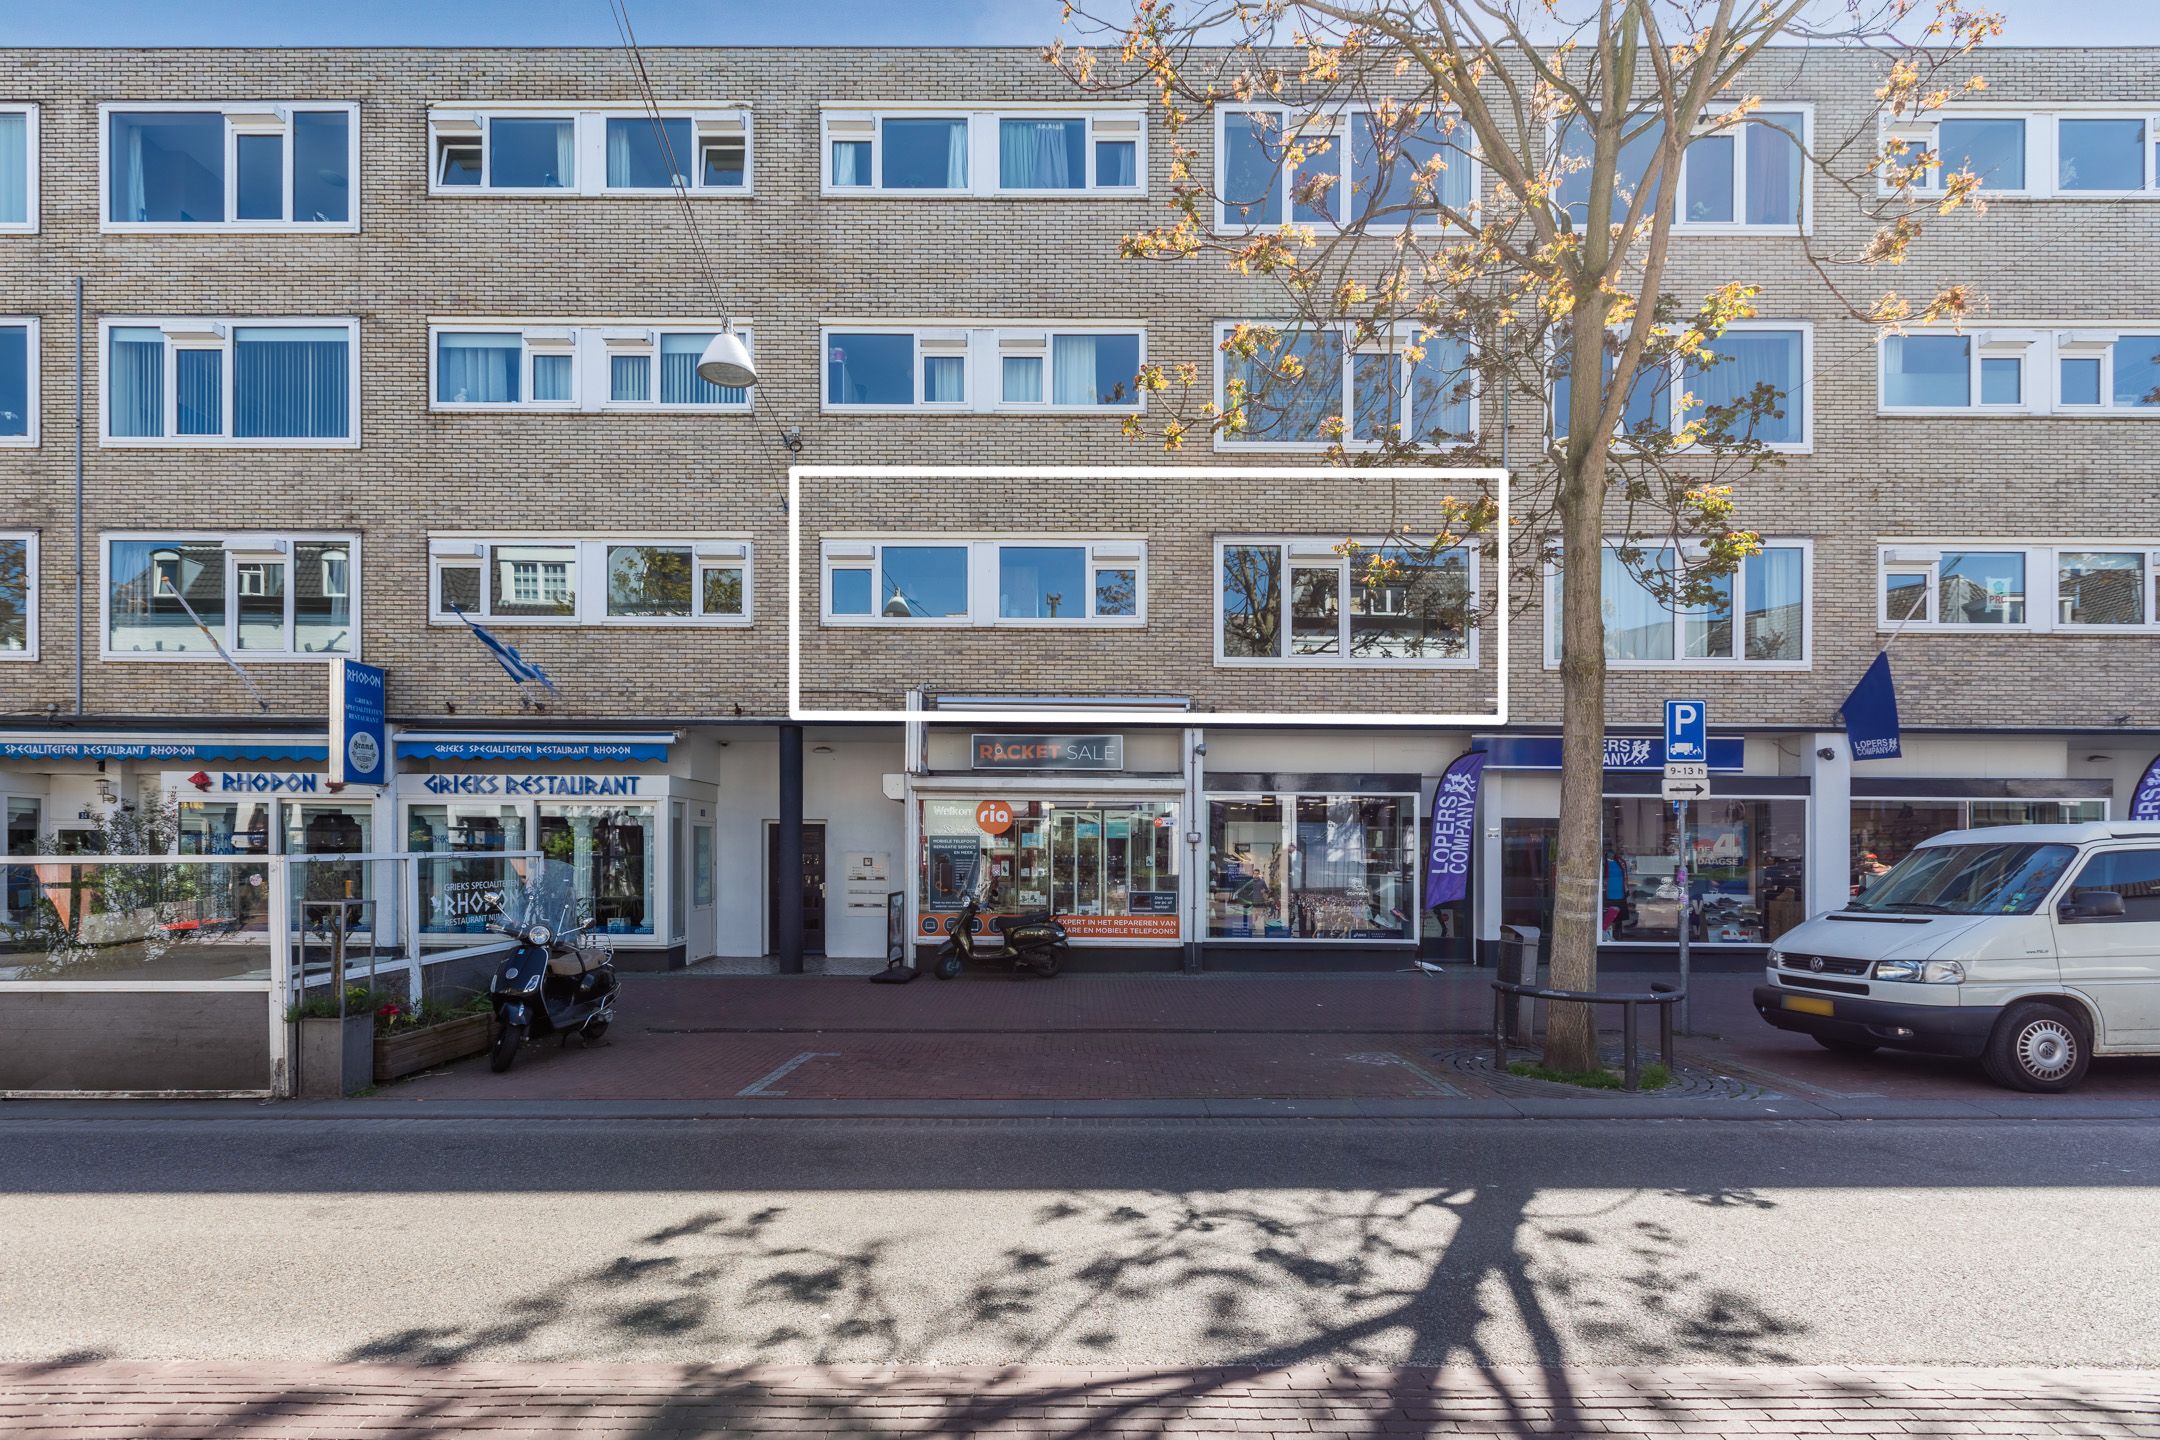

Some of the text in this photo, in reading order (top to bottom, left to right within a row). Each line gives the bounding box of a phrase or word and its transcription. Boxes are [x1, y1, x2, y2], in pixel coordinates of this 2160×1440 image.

[346, 668, 381, 688] RHODON
[1675, 704, 1697, 736] P
[4, 744, 195, 756] SPECIALITEITEN RESTAURANT RHODON
[434, 744, 631, 755] GRIEKS SPECIALITEITEN RESTAURANT RHODON
[1854, 738, 1889, 749] LOPERS
[1066, 744, 1116, 761] SALE
[1856, 746, 1889, 756] COMPANY
[1697, 767, 1704, 775] h
[222, 772, 317, 793] RHODON
[424, 774, 641, 796] GRIEKS RESTAURANT
[980, 804, 1009, 823] ria
[1431, 795, 1458, 874] LOPERS
[1448, 797, 1475, 874] COMPANY
[1712, 833, 1743, 858] 4
[1697, 858, 1739, 866] DAAGSE
[444, 882, 470, 892] GRIEKS
[445, 914, 487, 926] RESTAURANT
[1113, 919, 1160, 927] REPAREREN
